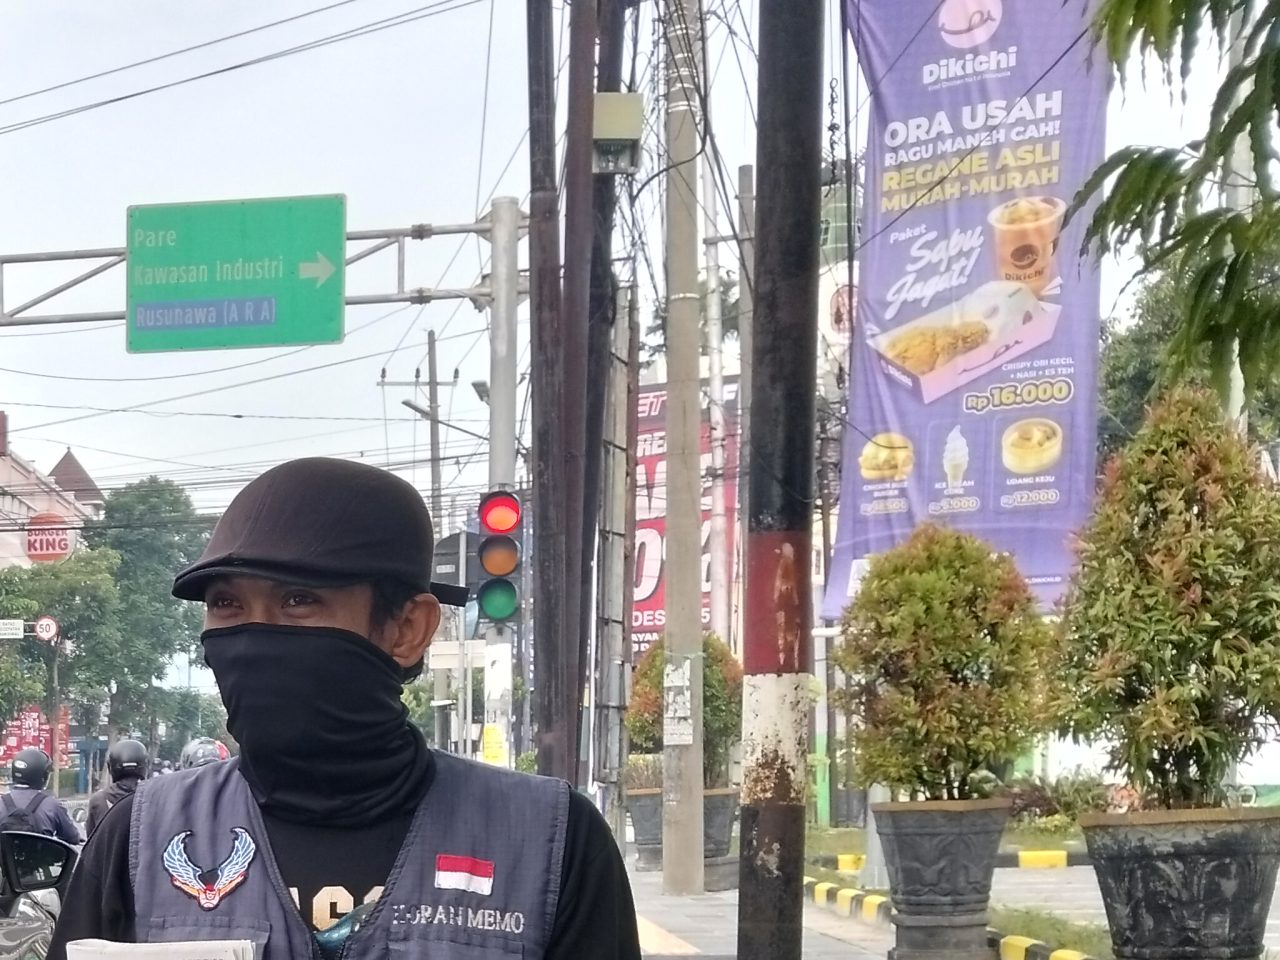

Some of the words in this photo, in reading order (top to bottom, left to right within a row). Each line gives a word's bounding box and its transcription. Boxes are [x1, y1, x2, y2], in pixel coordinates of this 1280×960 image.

[923, 46, 1017, 84] Dikichi
[884, 110, 954, 148] ORA
[962, 90, 1063, 130] USAH
[884, 143, 933, 167] RAGU
[937, 129, 1005, 155] MANEH
[1010, 120, 1061, 141] CAH!
[882, 150, 989, 192] REGANE
[995, 140, 1061, 170] ASLI
[881, 165, 1059, 213] MURAH-MURAH
[135, 229, 177, 247] Pare
[890, 224, 926, 243] Paket
[135, 264, 208, 285] Kawasan
[216, 256, 283, 281] Industri
[136, 306, 216, 327] Rusunawa
[990, 380, 1072, 405] 16.000
[27, 538, 69, 552] KING
[39, 623, 51, 633] 50
[467, 908, 524, 934] MEMO
